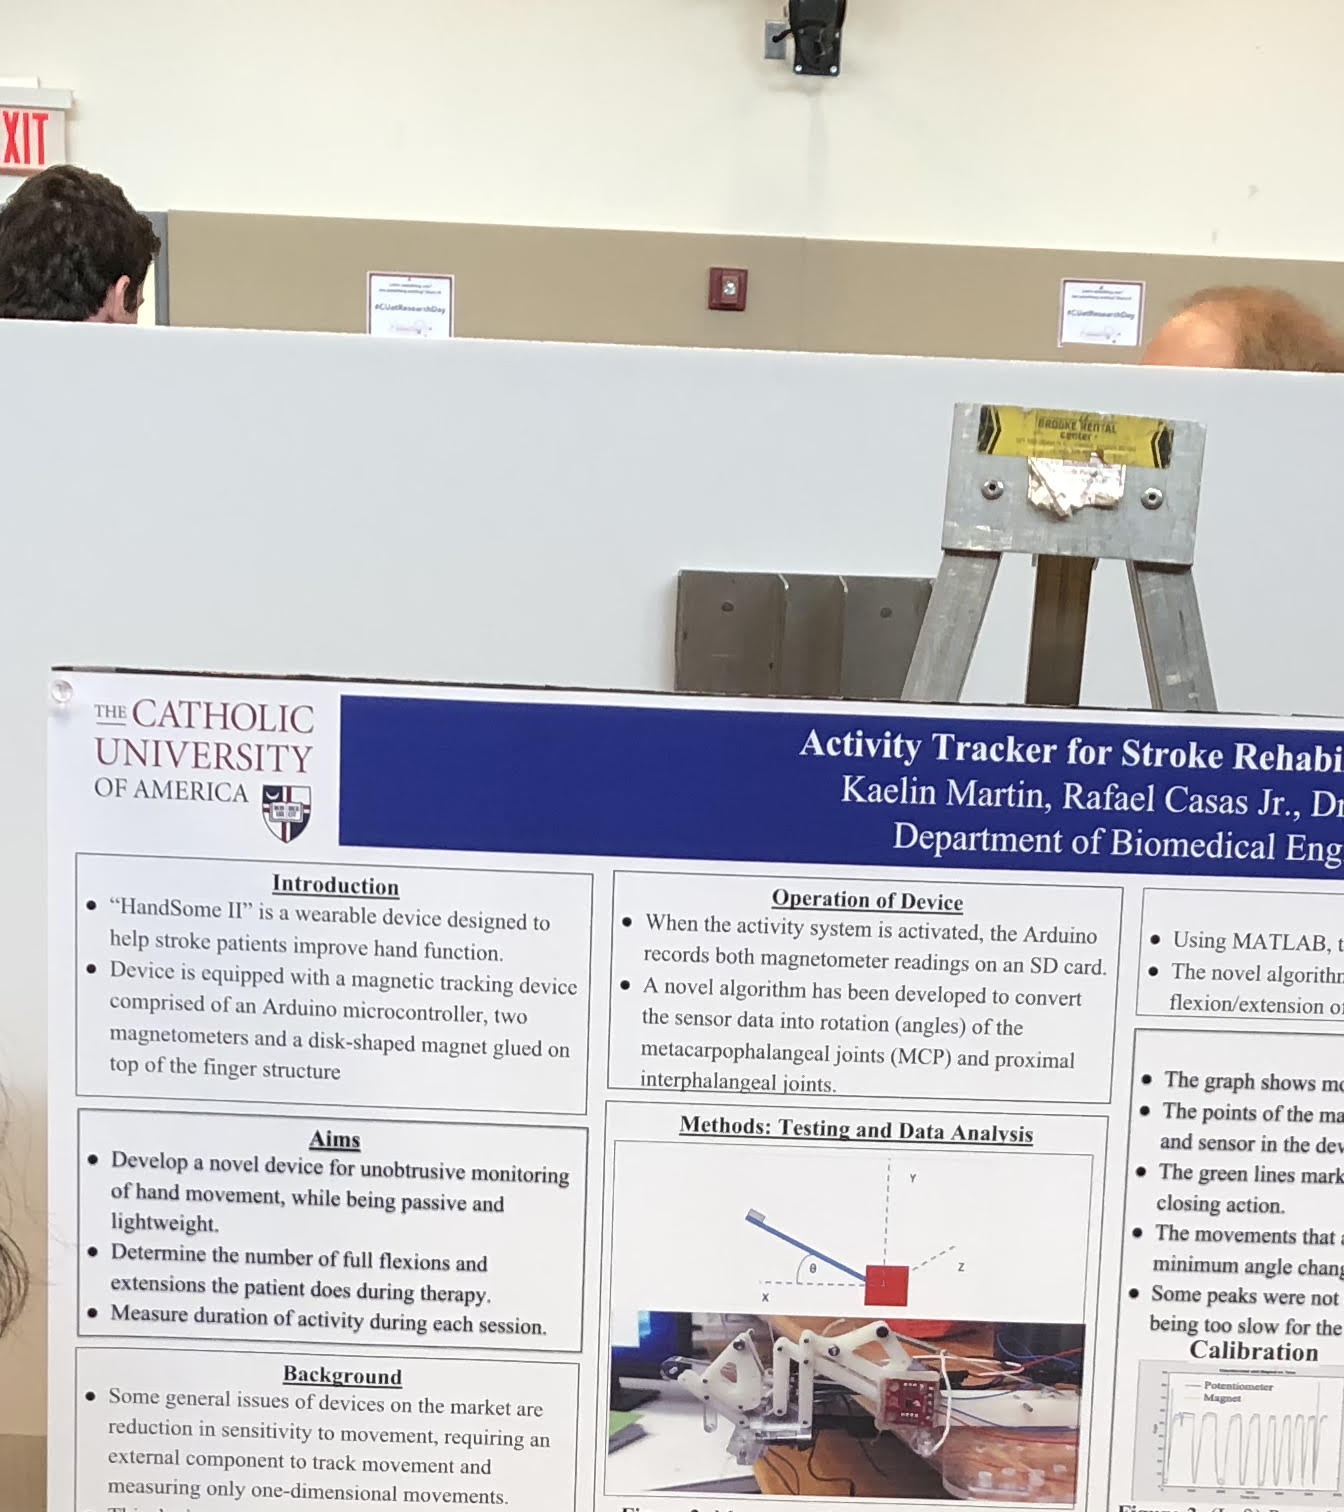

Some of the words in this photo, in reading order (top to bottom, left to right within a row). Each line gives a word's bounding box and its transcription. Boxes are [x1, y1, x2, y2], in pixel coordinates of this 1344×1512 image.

[95, 704, 129, 720] THE
[132, 698, 314, 734] CATHOLIC
[95, 737, 313, 774] UNIVERSITY
[799, 728, 923, 767] Activity
[932, 732, 1058, 764] Tracker
[1067, 737, 1113, 765] for
[1122, 739, 1224, 769] Stroke
[94, 777, 128, 798] OF
[133, 779, 249, 803] AMERICA
[841, 775, 936, 805] Kaelin
[946, 778, 1052, 814] Martin,
[1062, 782, 1155, 812] Rafael
[1165, 785, 1248, 815] Casas
[1257, 788, 1301, 822] Jr.,
[893, 821, 1063, 858] Department
[1071, 827, 1107, 855] of
[1110, 828, 1275, 860] Biomedical
[273, 874, 399, 896] Introduction
[772, 888, 870, 908] Operation
[876, 891, 897, 909] of
[901, 892, 964, 911] Device
[259, 902, 274, 920] is
[279, 908, 289, 921] a
[295, 906, 377, 925] wearable
[382, 907, 442, 927] device
[447, 910, 528, 934] designed
[533, 916, 551, 931] to
[309, 1129, 361, 1148] Aims
[680, 1115, 771, 1135] Methods:
[778, 1118, 850, 1139] Testing
[855, 1122, 892, 1139] and
[899, 1122, 944, 1140] Data
[950, 1124, 1033, 1143] Analysis
[1153, 1254, 1239, 1274] minimum
[1244, 1257, 1293, 1280] angle
[111, 1303, 189, 1323] Measure
[193, 1306, 268, 1326] duration
[273, 1309, 295, 1327] of
[297, 1311, 364, 1334] activity
[369, 1312, 428, 1336] during
[433, 1315, 474, 1333] each
[479, 1317, 547, 1335] session.
[1189, 1339, 1318, 1362] Calibration
[284, 1365, 402, 1385] Background
[1203, 1380, 1274, 1392] Potentiometer
[1203, 1393, 1242, 1404] Magnet
[108, 1478, 201, 1500] measuring
[206, 1480, 246, 1501] only
[251, 1482, 397, 1502] one-dimensional
[403, 1490, 509, 1505] movements.
